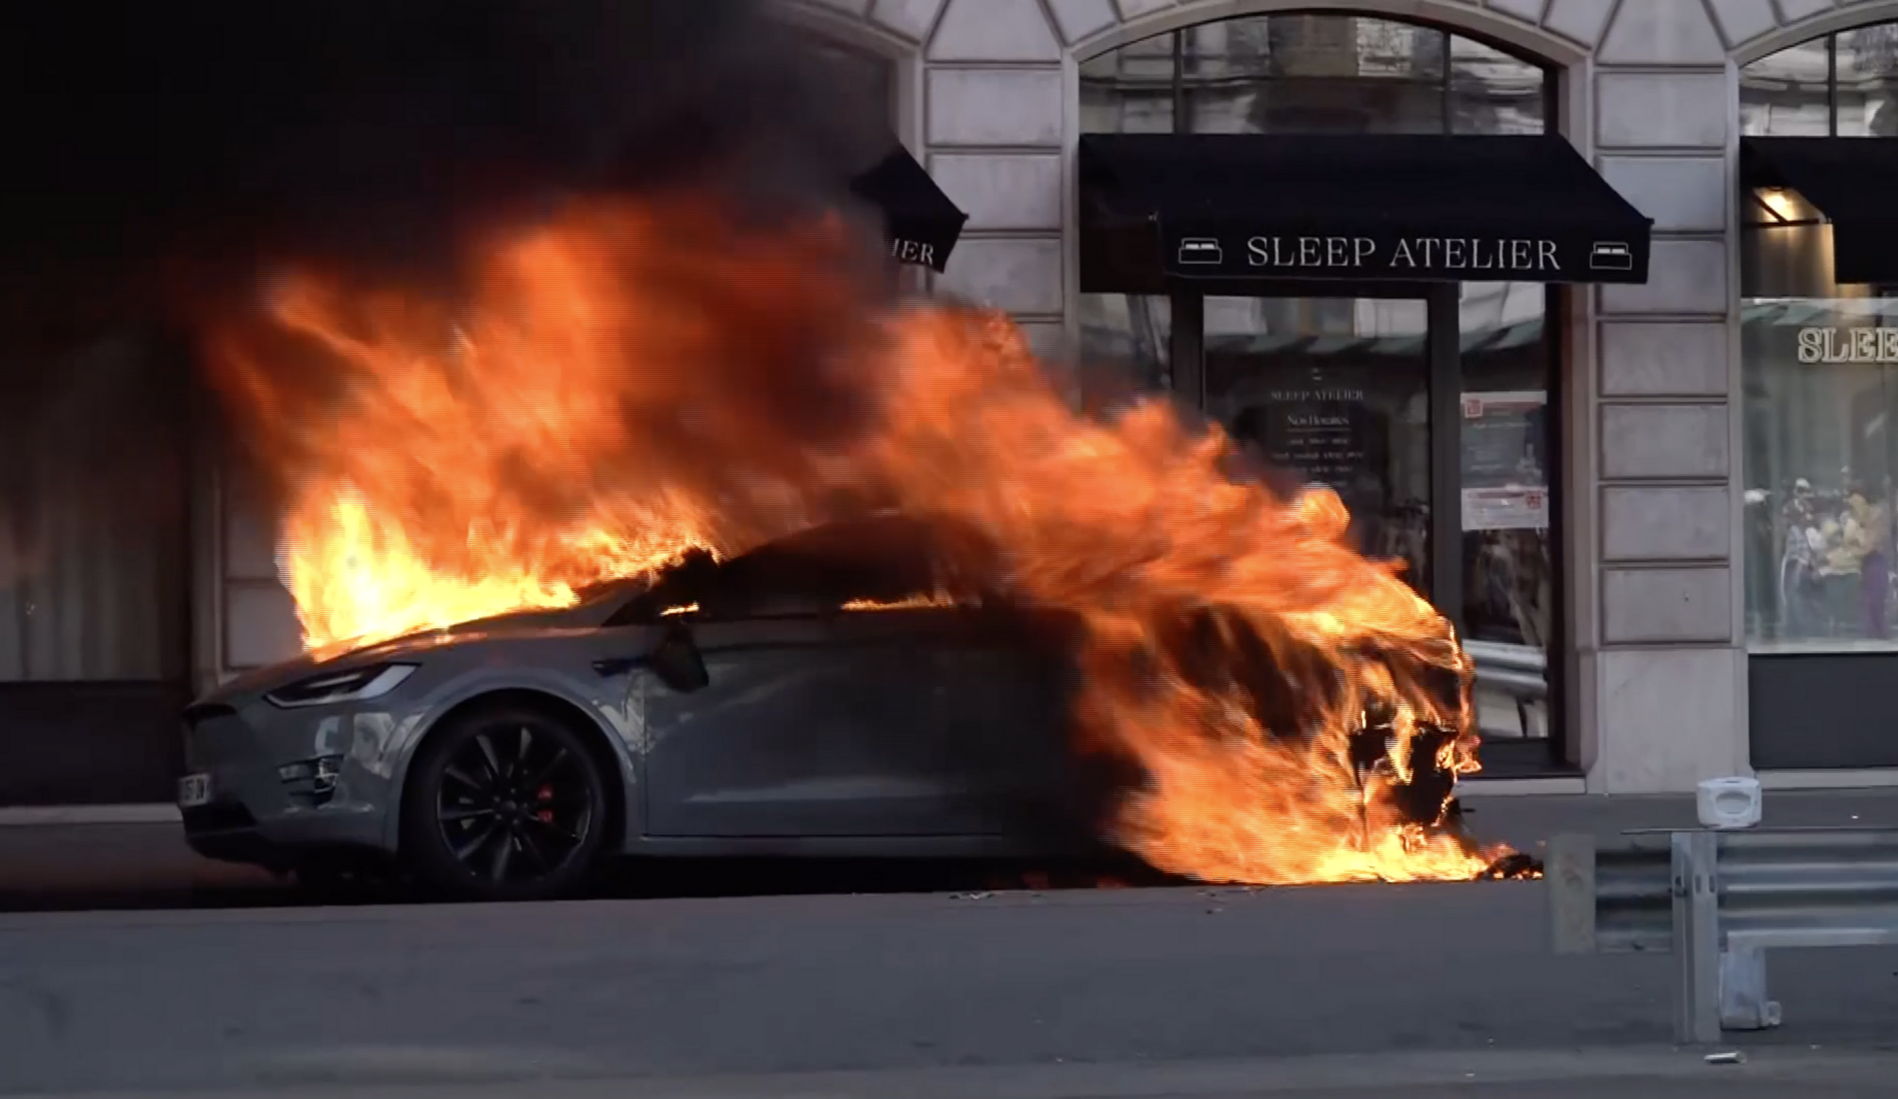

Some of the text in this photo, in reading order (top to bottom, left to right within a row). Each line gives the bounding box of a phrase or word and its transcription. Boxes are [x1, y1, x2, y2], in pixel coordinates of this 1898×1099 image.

[1247, 236, 1561, 270] SLEEP ATELIER
[1798, 327, 1898, 363] SLEE
[1314, 389, 1364, 401] ATELIER
